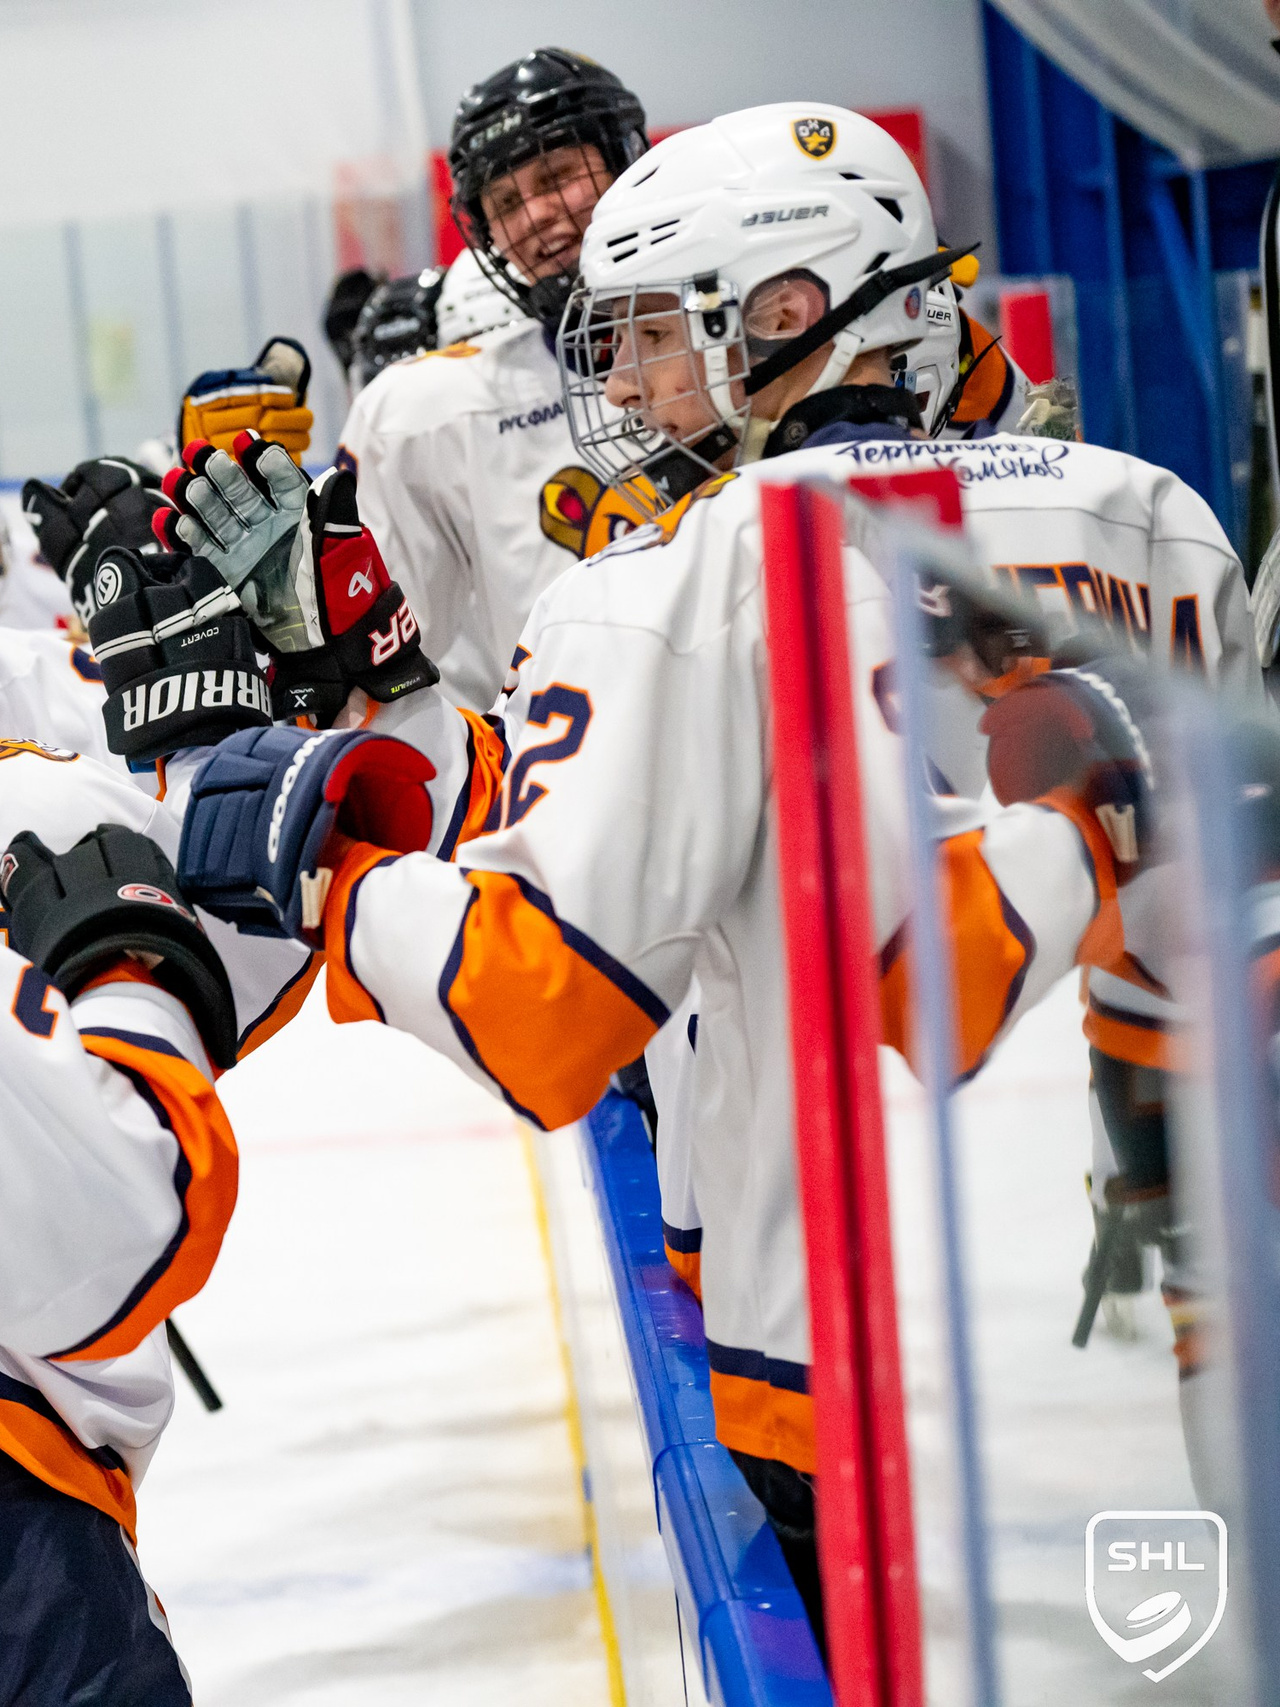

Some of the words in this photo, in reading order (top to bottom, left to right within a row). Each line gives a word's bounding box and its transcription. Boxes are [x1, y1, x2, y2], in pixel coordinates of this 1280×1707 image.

[927, 309, 952, 322] UER
[181, 627, 220, 648] COVERT
[122, 669, 270, 732] ARRIOR
